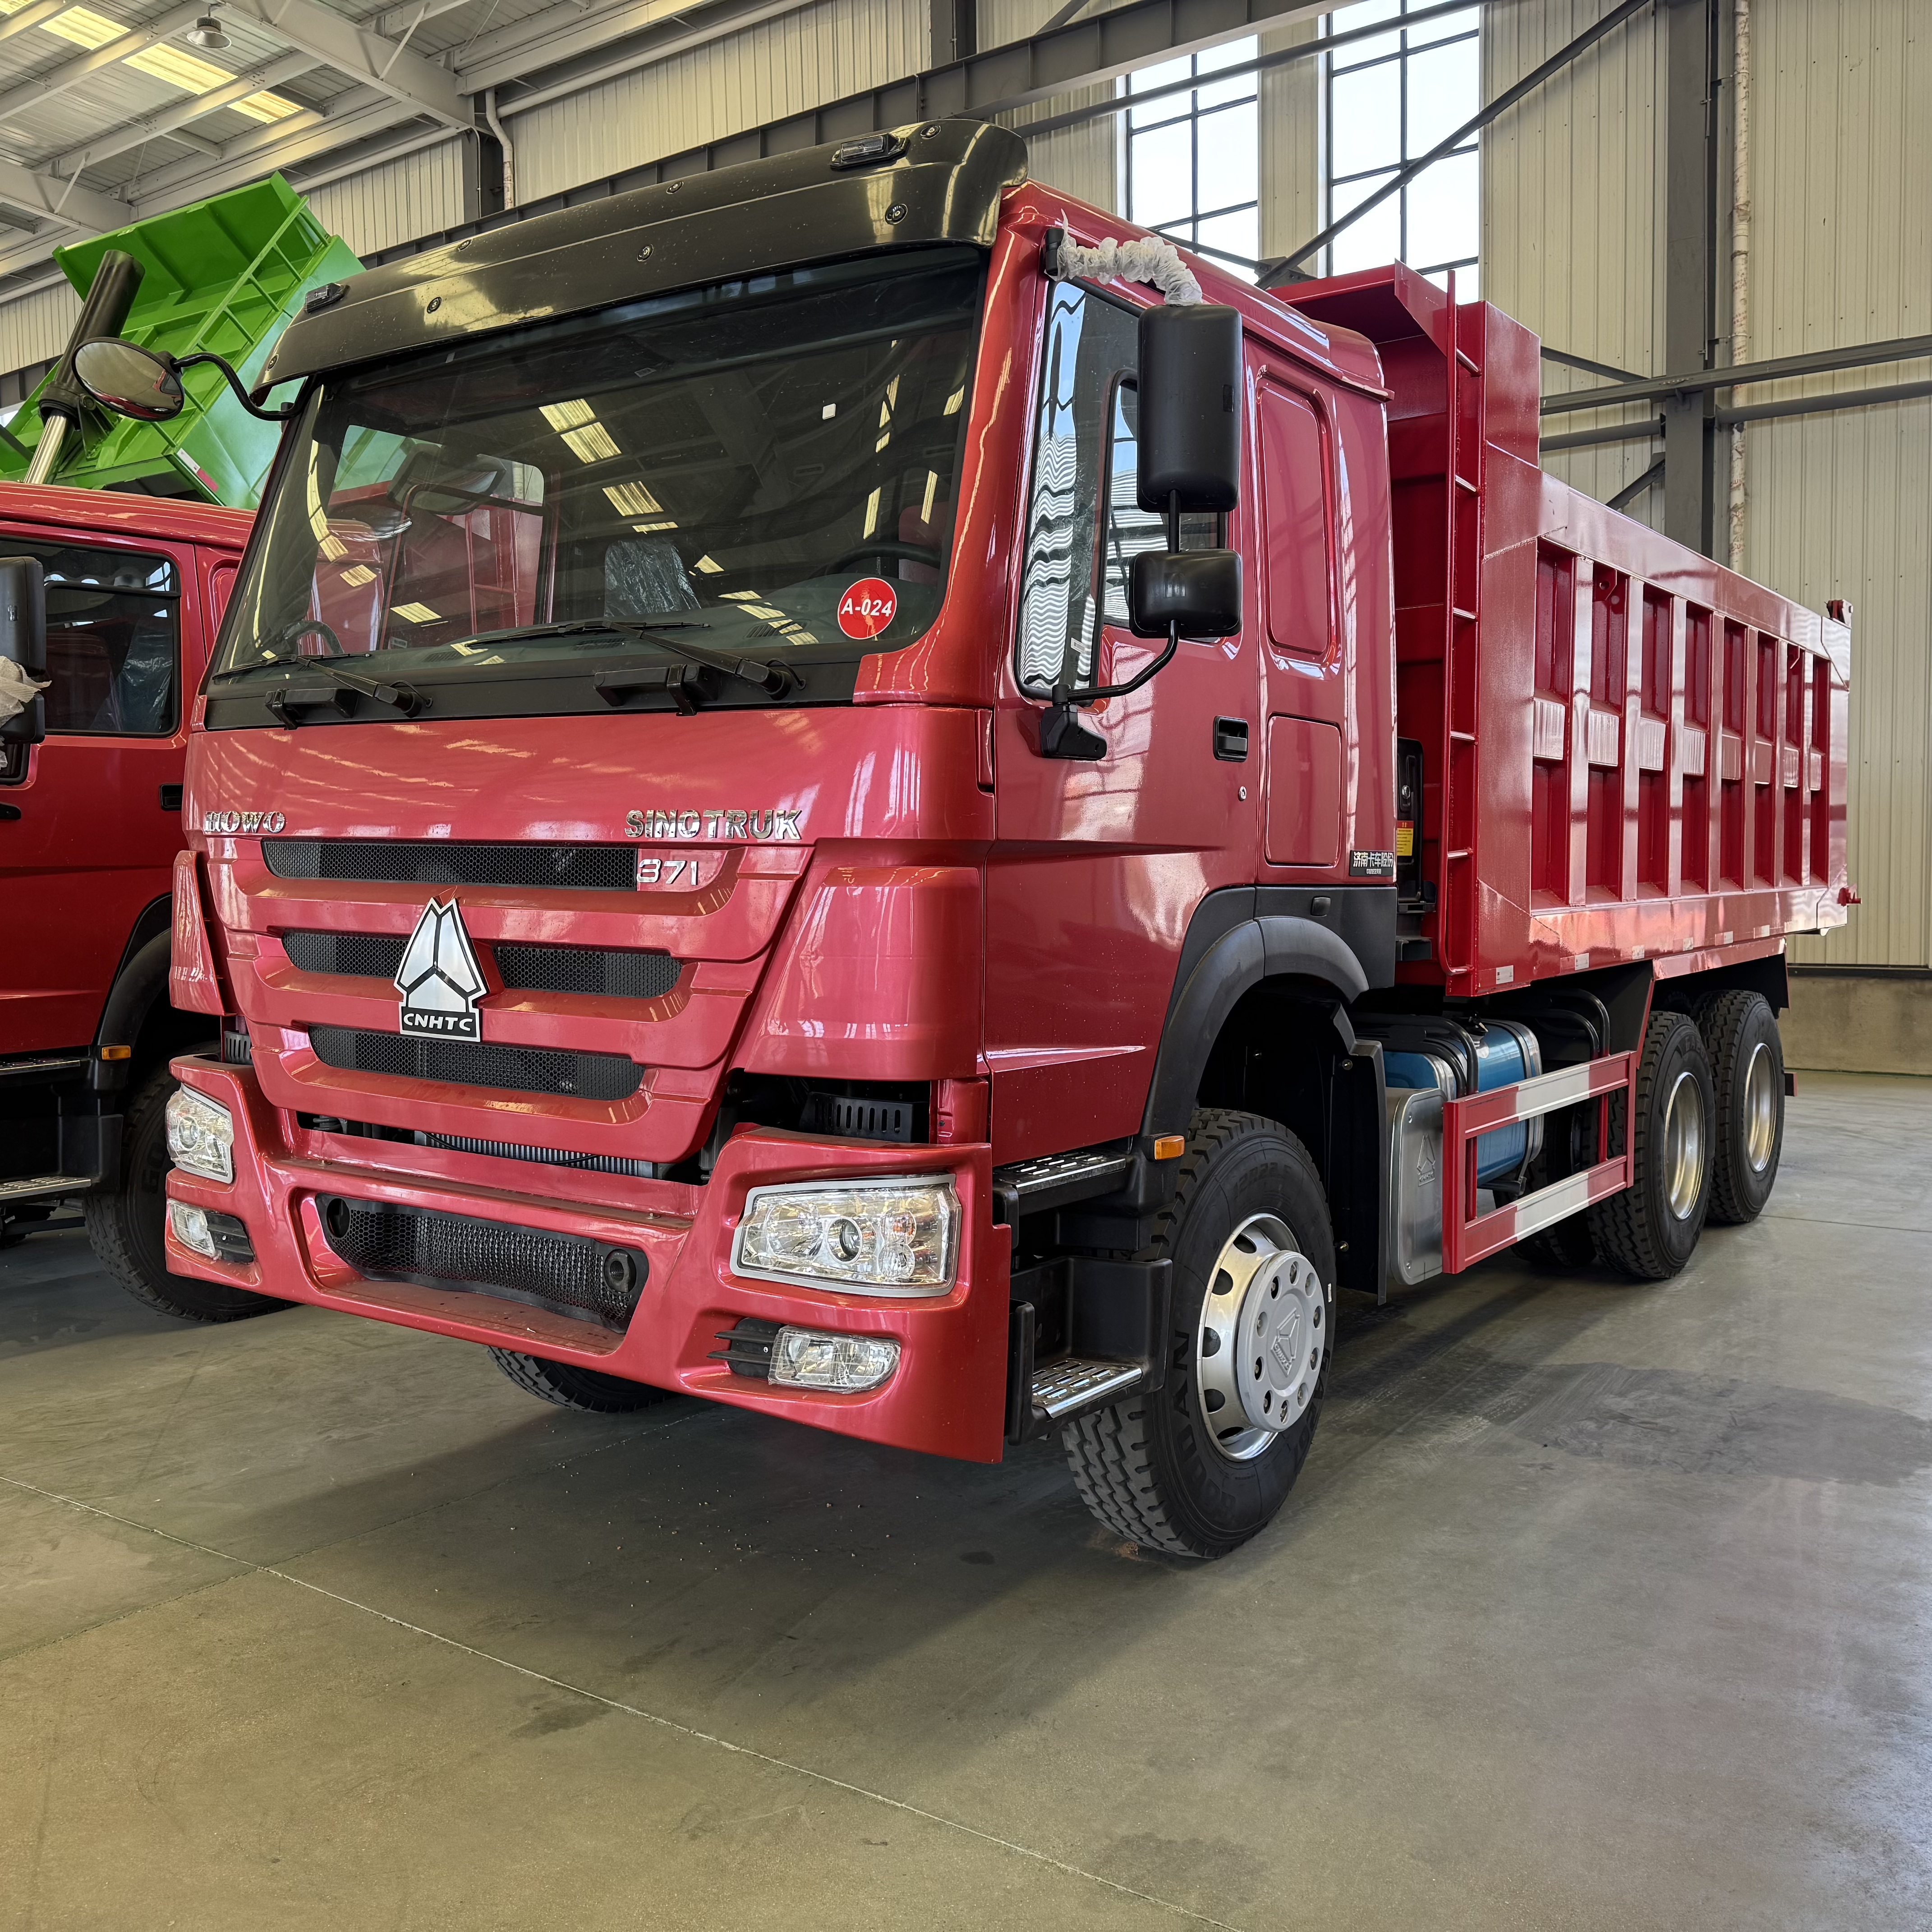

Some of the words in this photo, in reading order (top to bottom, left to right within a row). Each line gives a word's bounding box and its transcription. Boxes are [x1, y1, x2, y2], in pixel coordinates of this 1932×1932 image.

[841, 598, 892, 617] A-024
[203, 811, 286, 833] HOWO
[624, 809, 803, 840] SINOTRUK
[1353, 851, 1394, 868] 济南卡车股份
[636, 859, 698, 886] 371
[403, 1013, 473, 1031] CNHTC
